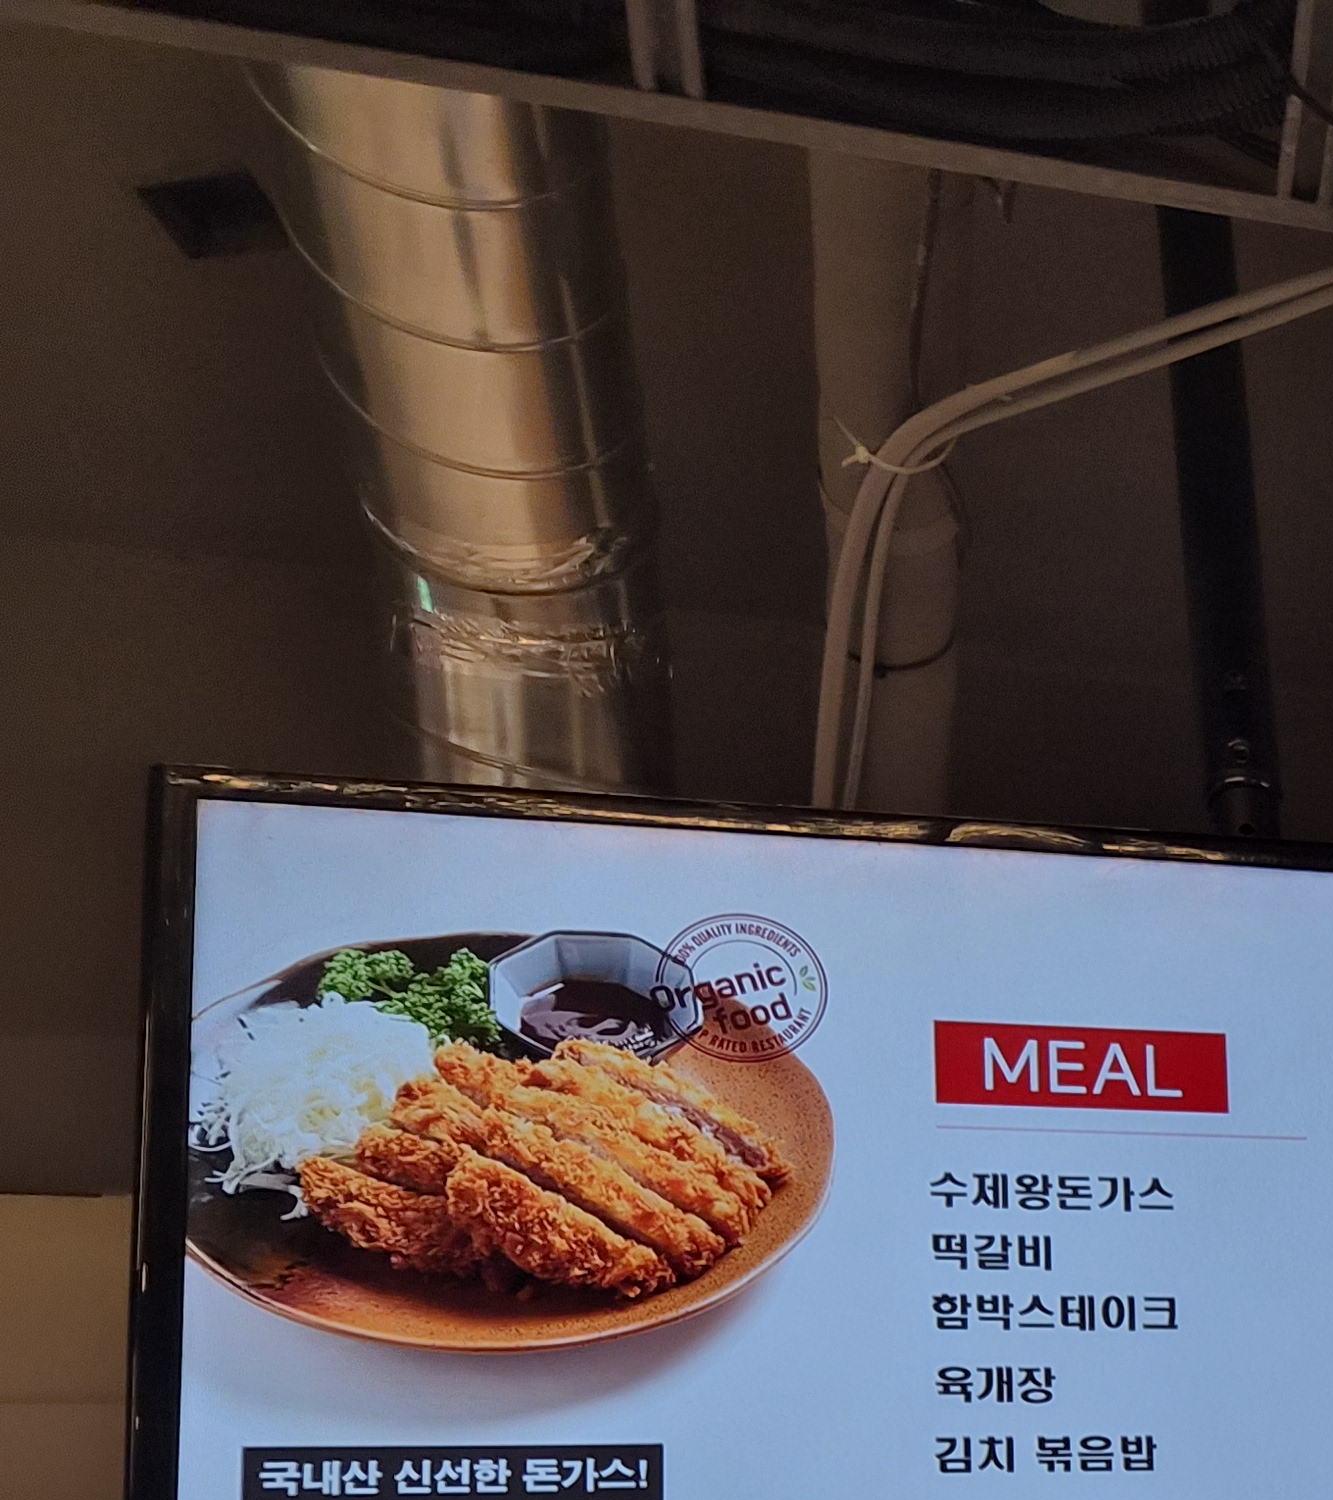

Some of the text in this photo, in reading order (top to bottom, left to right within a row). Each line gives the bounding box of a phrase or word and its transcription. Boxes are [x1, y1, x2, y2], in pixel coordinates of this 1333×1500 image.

[690, 923, 733, 947] QUALITY
[734, 922, 802, 958] INGREDIENTS
[649, 962, 787, 1012] Organic
[710, 1034, 748, 1054] RATED
[752, 1006, 813, 1053] RESTAURANT
[712, 992, 793, 1035] food
[984, 1037, 1182, 1097] MEAL
[931, 1173, 1173, 1212] 수제왕돈가스
[933, 1234, 1051, 1270] 떡갈비
[933, 1294, 1178, 1331] 함박스테이크
[936, 1367, 1055, 1403] 육개장
[936, 1437, 1014, 1473] 김치
[1037, 1436, 1156, 1472] 볶음밥
[259, 1458, 647, 1496] 국내산 신선한 돈가스!
